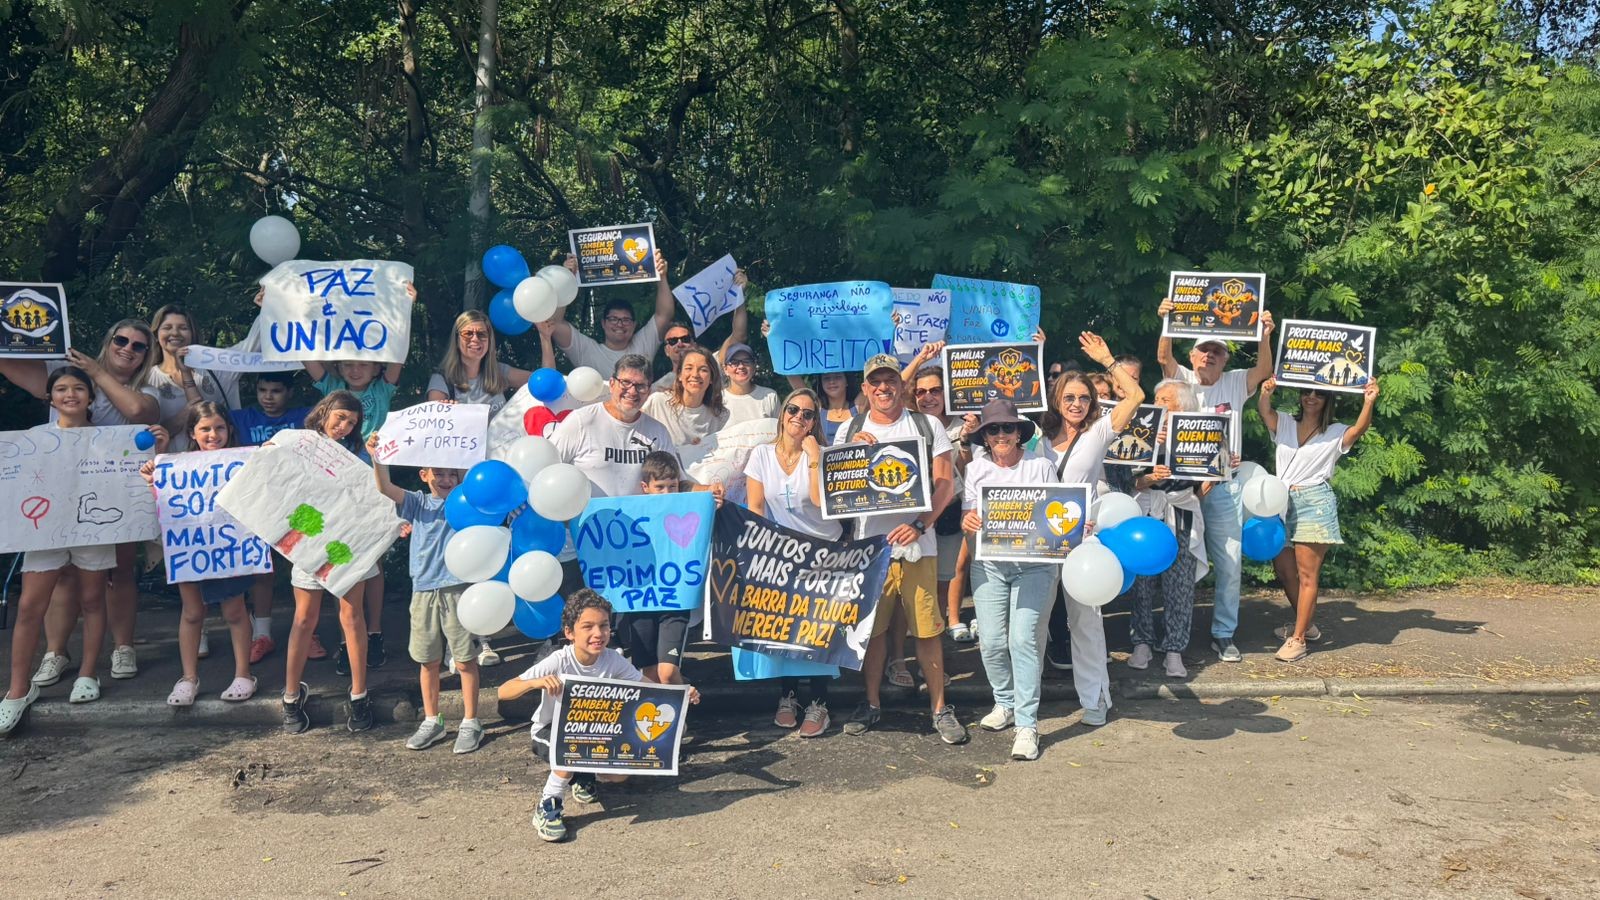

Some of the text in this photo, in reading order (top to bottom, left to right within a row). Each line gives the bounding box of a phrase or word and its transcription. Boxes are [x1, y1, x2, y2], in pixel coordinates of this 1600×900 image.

[578, 230, 622, 243] SEGURANÇA
[606, 240, 615, 248] SE
[581, 256, 596, 264] COM
[300, 268, 376, 297] PAZ
[1175, 277, 1210, 287] FAMÍLIAS
[851, 283, 871, 297] NÃO
[893, 291, 947, 304] EDO NÃO
[1173, 295, 1201, 303] BAIRRO
[270, 310, 387, 353] UNIÃO
[1288, 327, 1348, 342] PROTEGENDO
[1286, 338, 1343, 352] QUEM MAIS
[951, 349, 986, 360] FAMÍLIAS
[1284, 349, 1332, 363] AMAMOS.
[951, 360, 981, 369] UNIDAS.
[951, 368, 979, 378] BAIRRO
[951, 377, 989, 387] PROTEGIDO.
[397, 403, 452, 419] JUNTOS
[405, 418, 454, 431] SOMOS
[424, 436, 477, 450] FORTES
[1176, 431, 1206, 442] QUEM
[604, 447, 646, 464] PUMA
[826, 448, 866, 462] CUIDAR DA
[826, 459, 870, 471] COMUNIDADE
[827, 469, 869, 481] E PROTEGER
[827, 479, 868, 491] O FUTURO.
[987, 489, 1047, 503] SEGURANÇA
[988, 500, 1033, 510] TAMBÉM SE
[987, 510, 1033, 521] CONSTRÓI
[577, 508, 651, 551] NÓS
[986, 520, 1037, 530] COM UNIÃO.
[736, 520, 875, 570] JUNTOS SOMOS
[170, 535, 271, 581] FORTES!
[746, 554, 865, 600] MAIS FORTES.
[621, 587, 682, 610] PAZ
[729, 583, 859, 625] A BARRA DA TIJUCA
[731, 610, 836, 649] MERECE PAZ!
[570, 684, 641, 703] SEGURANÇA
[569, 698, 624, 711] TAMBÉM SE
[566, 710, 620, 724] CONSTRÓI
[564, 722, 623, 735] COM UNIÃO.
